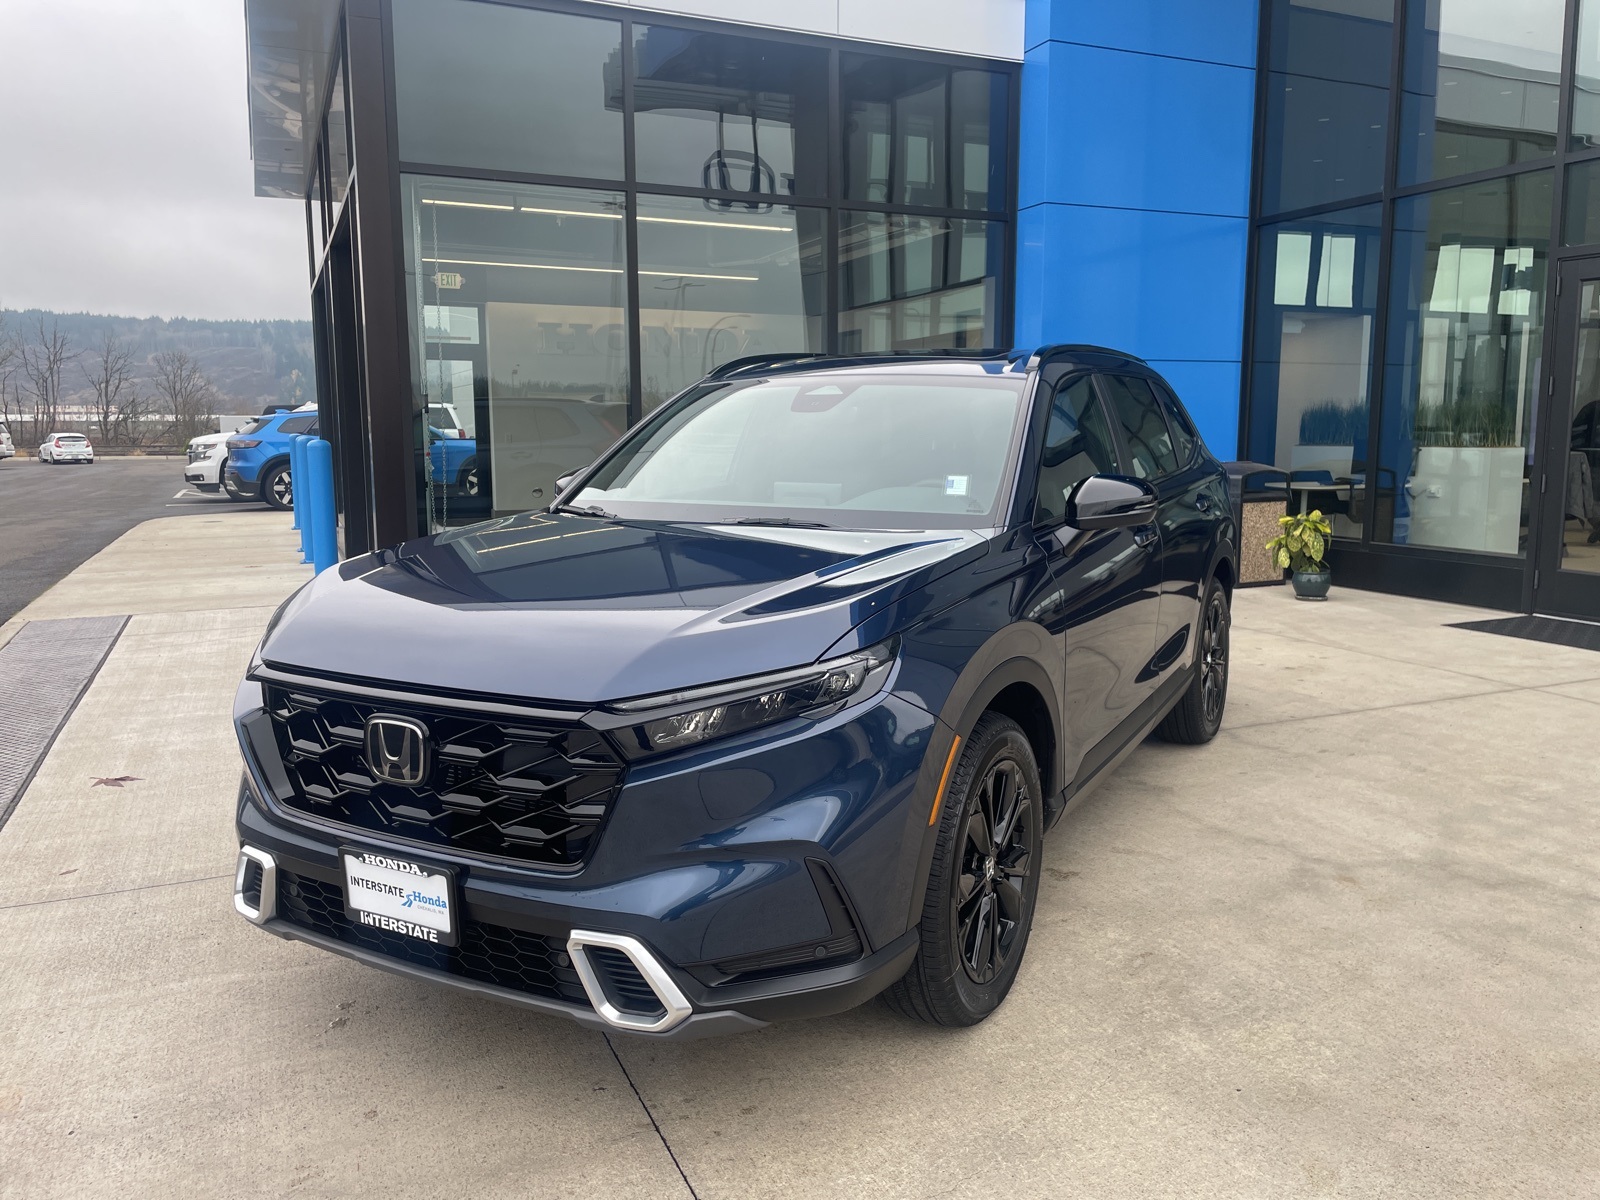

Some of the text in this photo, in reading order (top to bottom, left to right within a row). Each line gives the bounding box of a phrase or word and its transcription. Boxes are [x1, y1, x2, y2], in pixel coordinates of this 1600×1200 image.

[440, 273, 457, 287] EXIT
[363, 853, 422, 876] HONDA
[350, 875, 447, 909] INTERSTATE Honda
[360, 911, 439, 943] INTERSTATE
